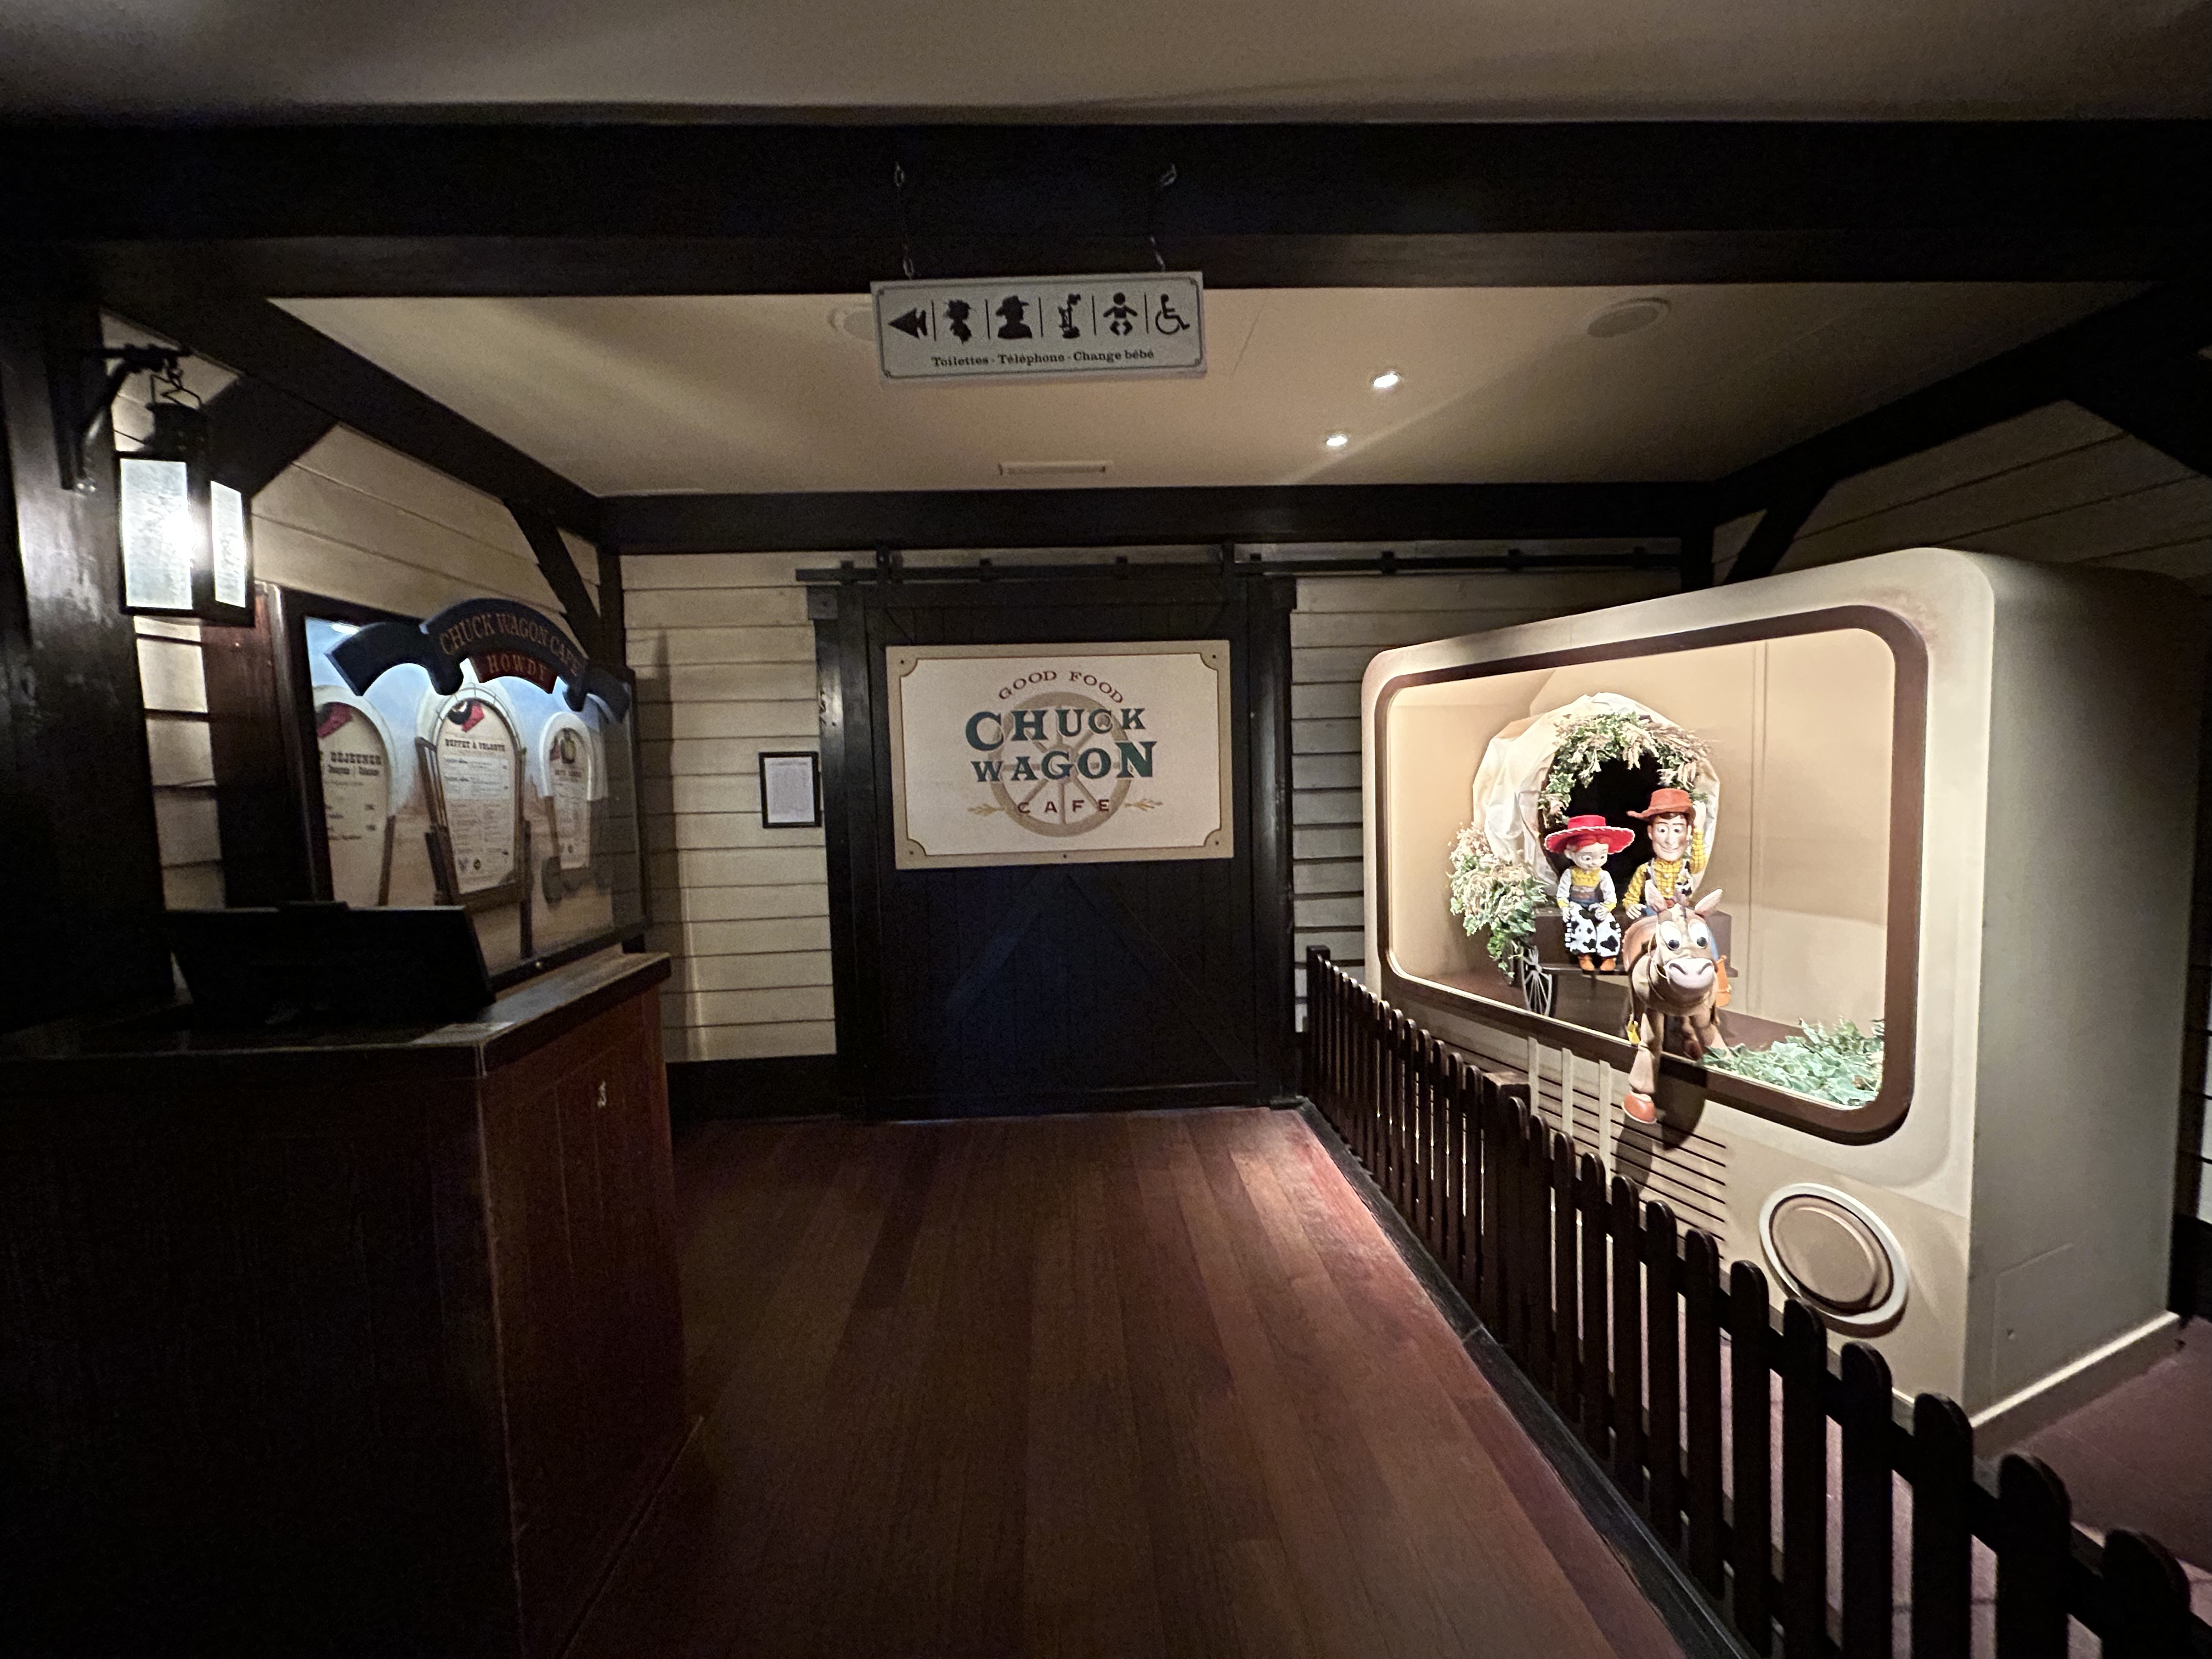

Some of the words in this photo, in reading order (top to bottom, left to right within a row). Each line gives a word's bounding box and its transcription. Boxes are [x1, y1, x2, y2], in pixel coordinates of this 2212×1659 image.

[932, 356, 989, 366] Toilettes
[1073, 351, 1121, 363] Change
[440, 613, 495, 655] CHUCK
[496, 612, 548, 646] WAGON
[487, 653, 545, 681] HOWDY
[998, 670, 1057, 700] GOOD
[1069, 671, 1123, 703] FOOD
[965, 708, 1146, 752] CHUCK
[970, 741, 1157, 782] WAGON
[1017, 799, 1110, 814] CAFE
